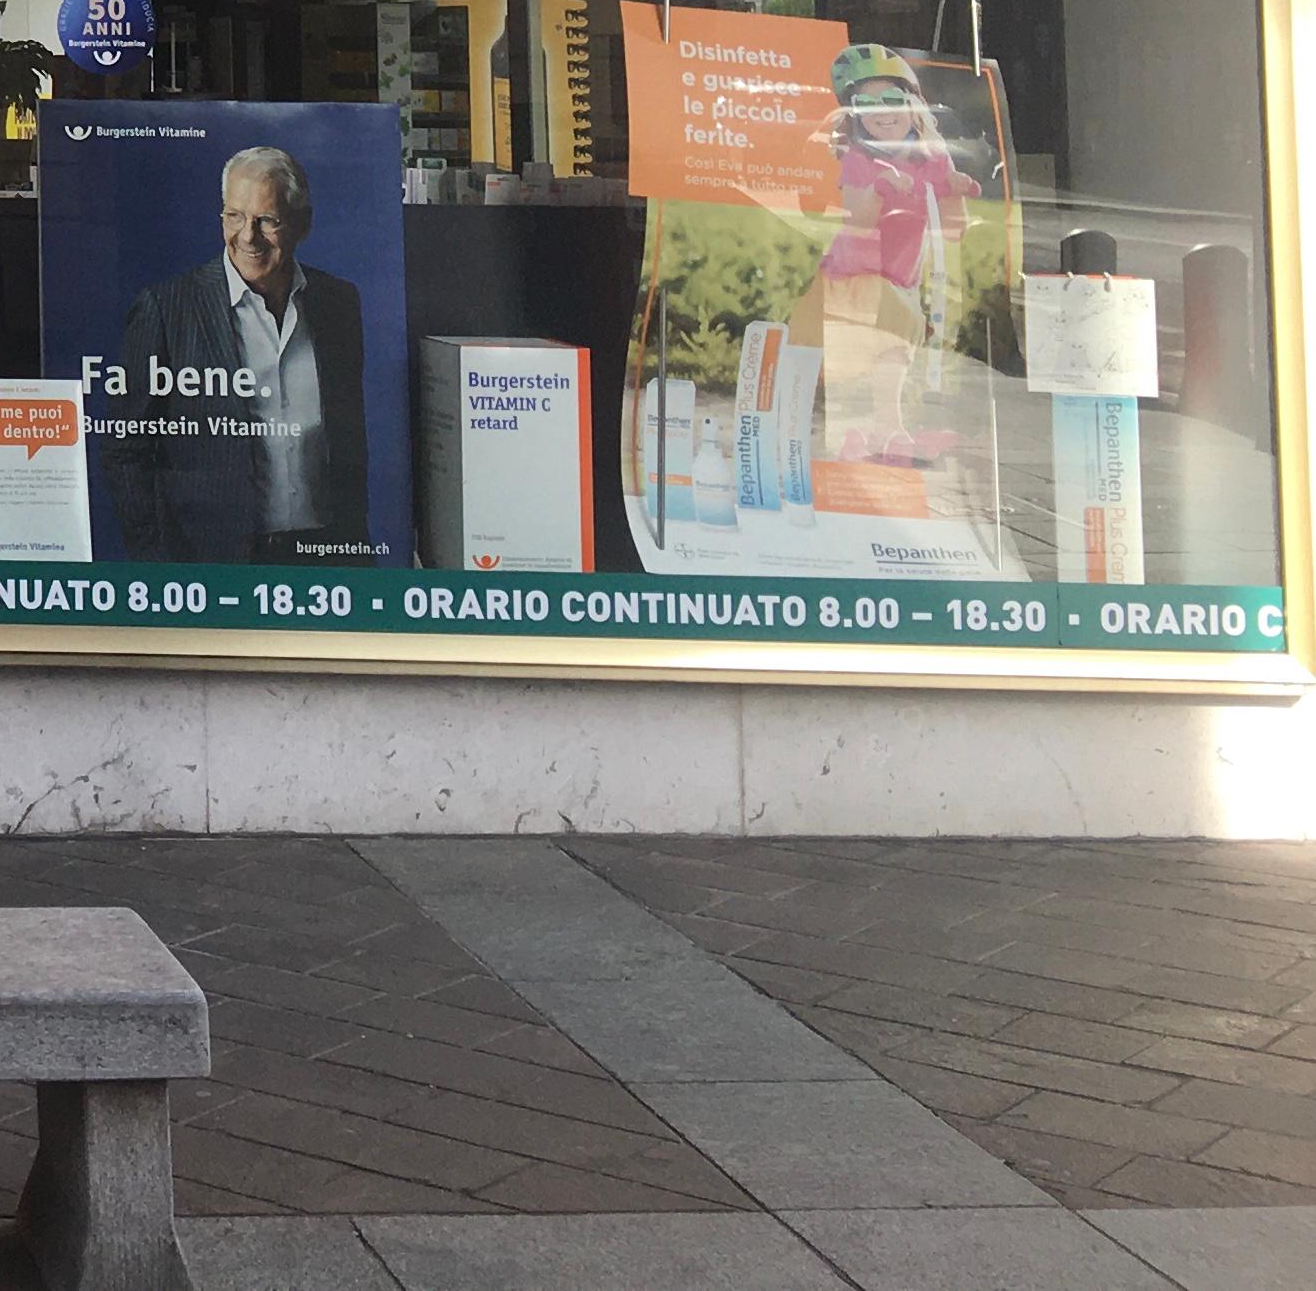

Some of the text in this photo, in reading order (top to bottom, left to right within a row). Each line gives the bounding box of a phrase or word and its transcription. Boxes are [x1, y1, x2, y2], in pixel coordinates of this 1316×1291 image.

[82, 22, 131, 36] ANNI
[68, 39, 112, 48] Burgerstein
[679, 40, 792, 69] Disinfetta
[681, 71, 802, 96] e guarisce
[683, 95, 797, 123] le piccole
[96, 125, 206, 140] Burgerstein Vitamine
[684, 123, 755, 149] ferite.
[684, 156, 824, 180] Così Eva può andare
[684, 174, 734, 189] sempre
[80, 355, 272, 398] Fa bene.
[468, 371, 570, 392] Burgerstein
[469, 396, 551, 412] VITAMIN C
[739, 381, 755, 412] Plus
[0, 405, 63, 422] me puoi
[470, 415, 519, 431] retard
[647, 413, 692, 426] Beanthen
[80, 413, 301, 439] Burgerstein Vitamine
[752, 416, 761, 438] MED
[739, 414, 756, 508] Bepanthen
[1105, 401, 1123, 503] Bepanthen
[1097, 478, 1107, 502] MED
[1107, 506, 1126, 540] Plus
[296, 540, 390, 557] burgerstein.ch
[870, 542, 977, 562] Bepanthen
[127, 581, 207, 613] 8.00
[252, 584, 352, 616] 18.30
[403, 587, 550, 621] ORARIO
[561, 590, 807, 627] CONTINUATO
[818, 596, 900, 629] 8.00
[947, 599, 1047, 632] 18.30
[1100, 602, 1247, 637] ORARIO
[1257, 604, 1284, 638] C
